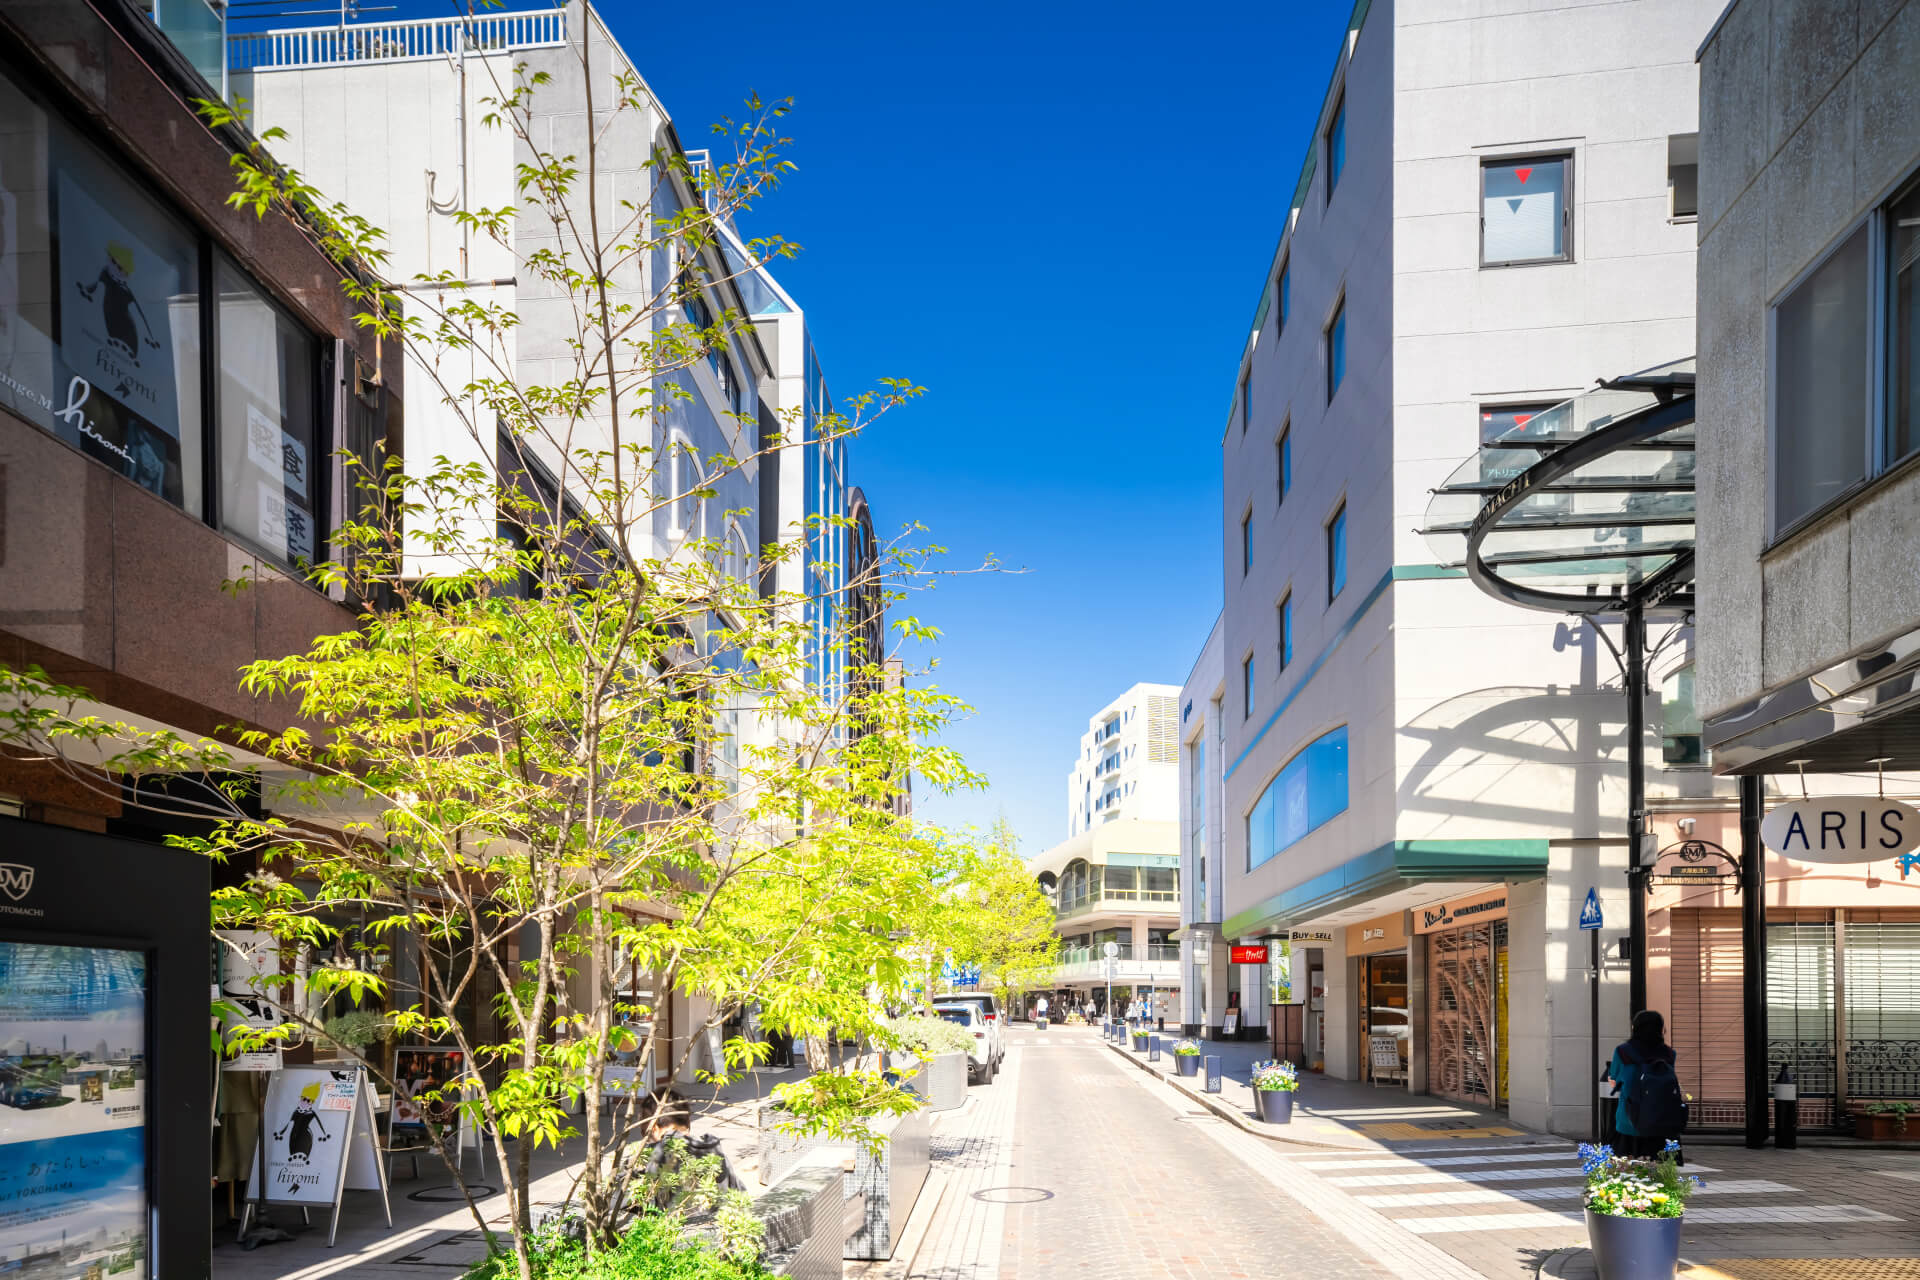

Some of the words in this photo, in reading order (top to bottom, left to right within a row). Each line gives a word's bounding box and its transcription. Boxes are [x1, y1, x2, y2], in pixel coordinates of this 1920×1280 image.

[54, 376, 136, 464] hiromi
[1783, 809, 1904, 850] ARIS
[1292, 931, 1309, 939] BUY
[277, 1167, 320, 1185] hiromi
